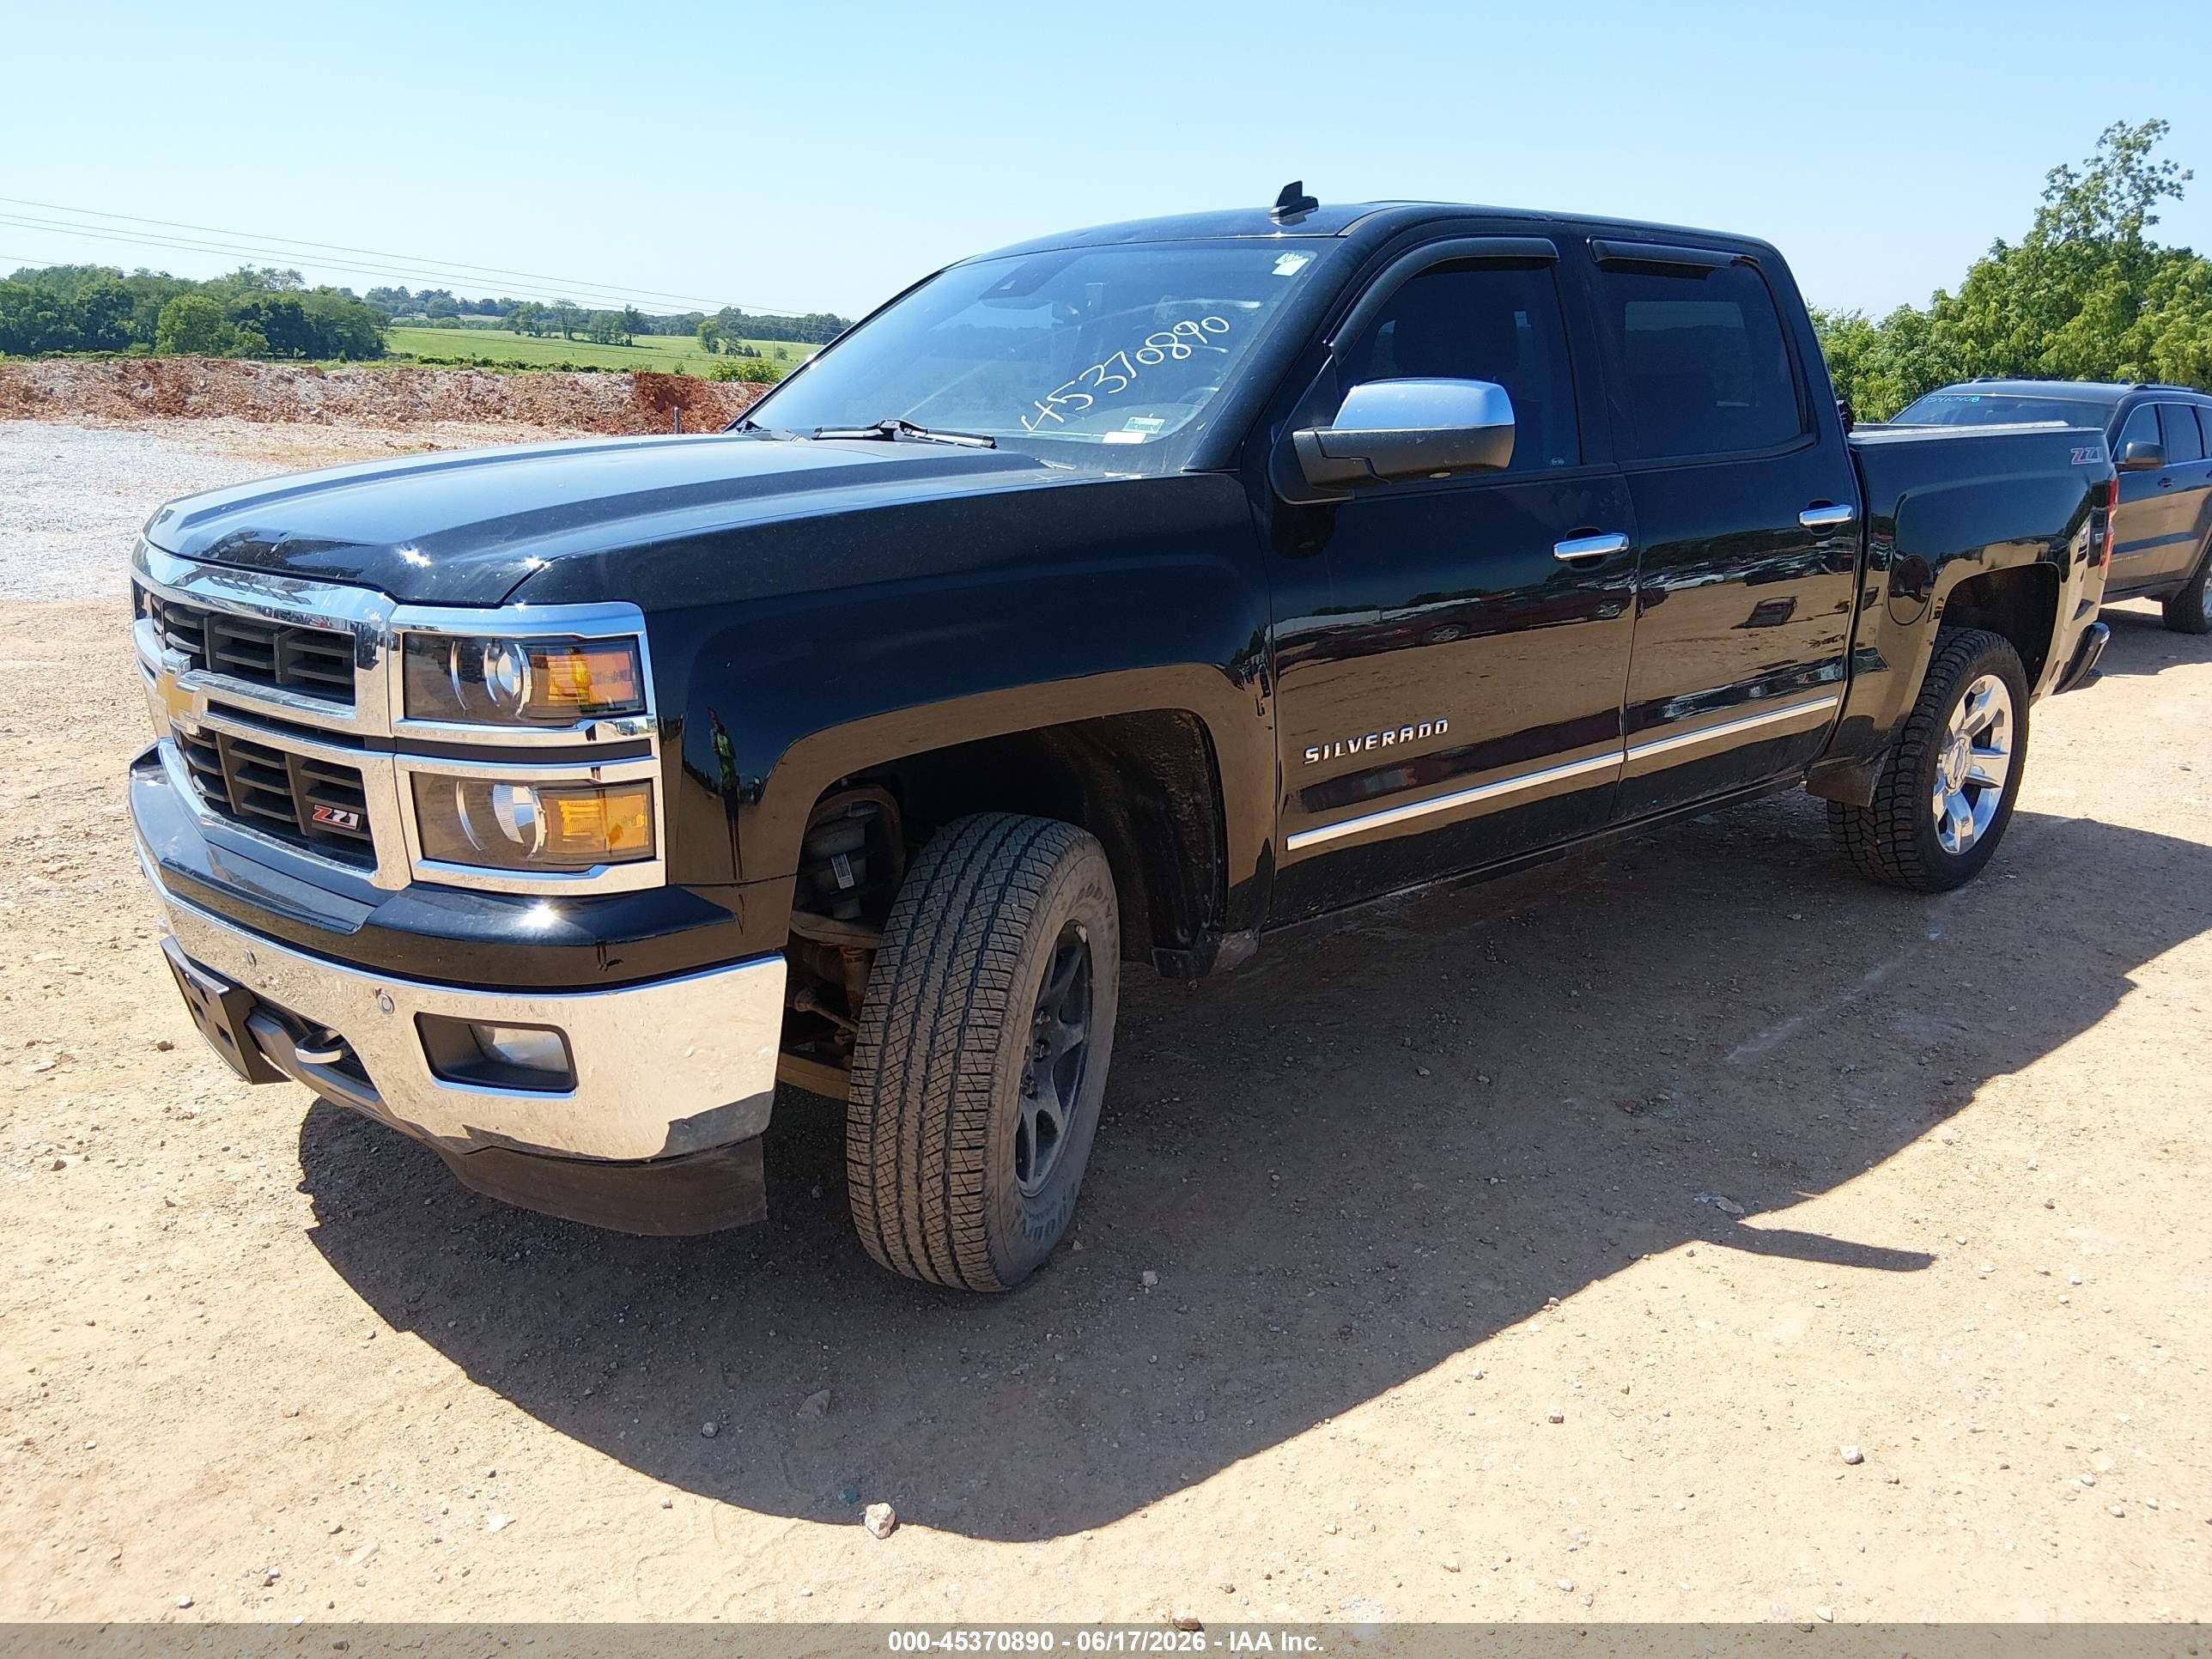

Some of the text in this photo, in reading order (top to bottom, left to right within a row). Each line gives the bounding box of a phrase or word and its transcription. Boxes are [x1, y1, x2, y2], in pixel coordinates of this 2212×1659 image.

[1020, 316, 1230, 432] 45370890
[2070, 447, 2103, 465] Z71
[1304, 718, 1449, 764] SILVERADO
[313, 805, 359, 830] Z71
